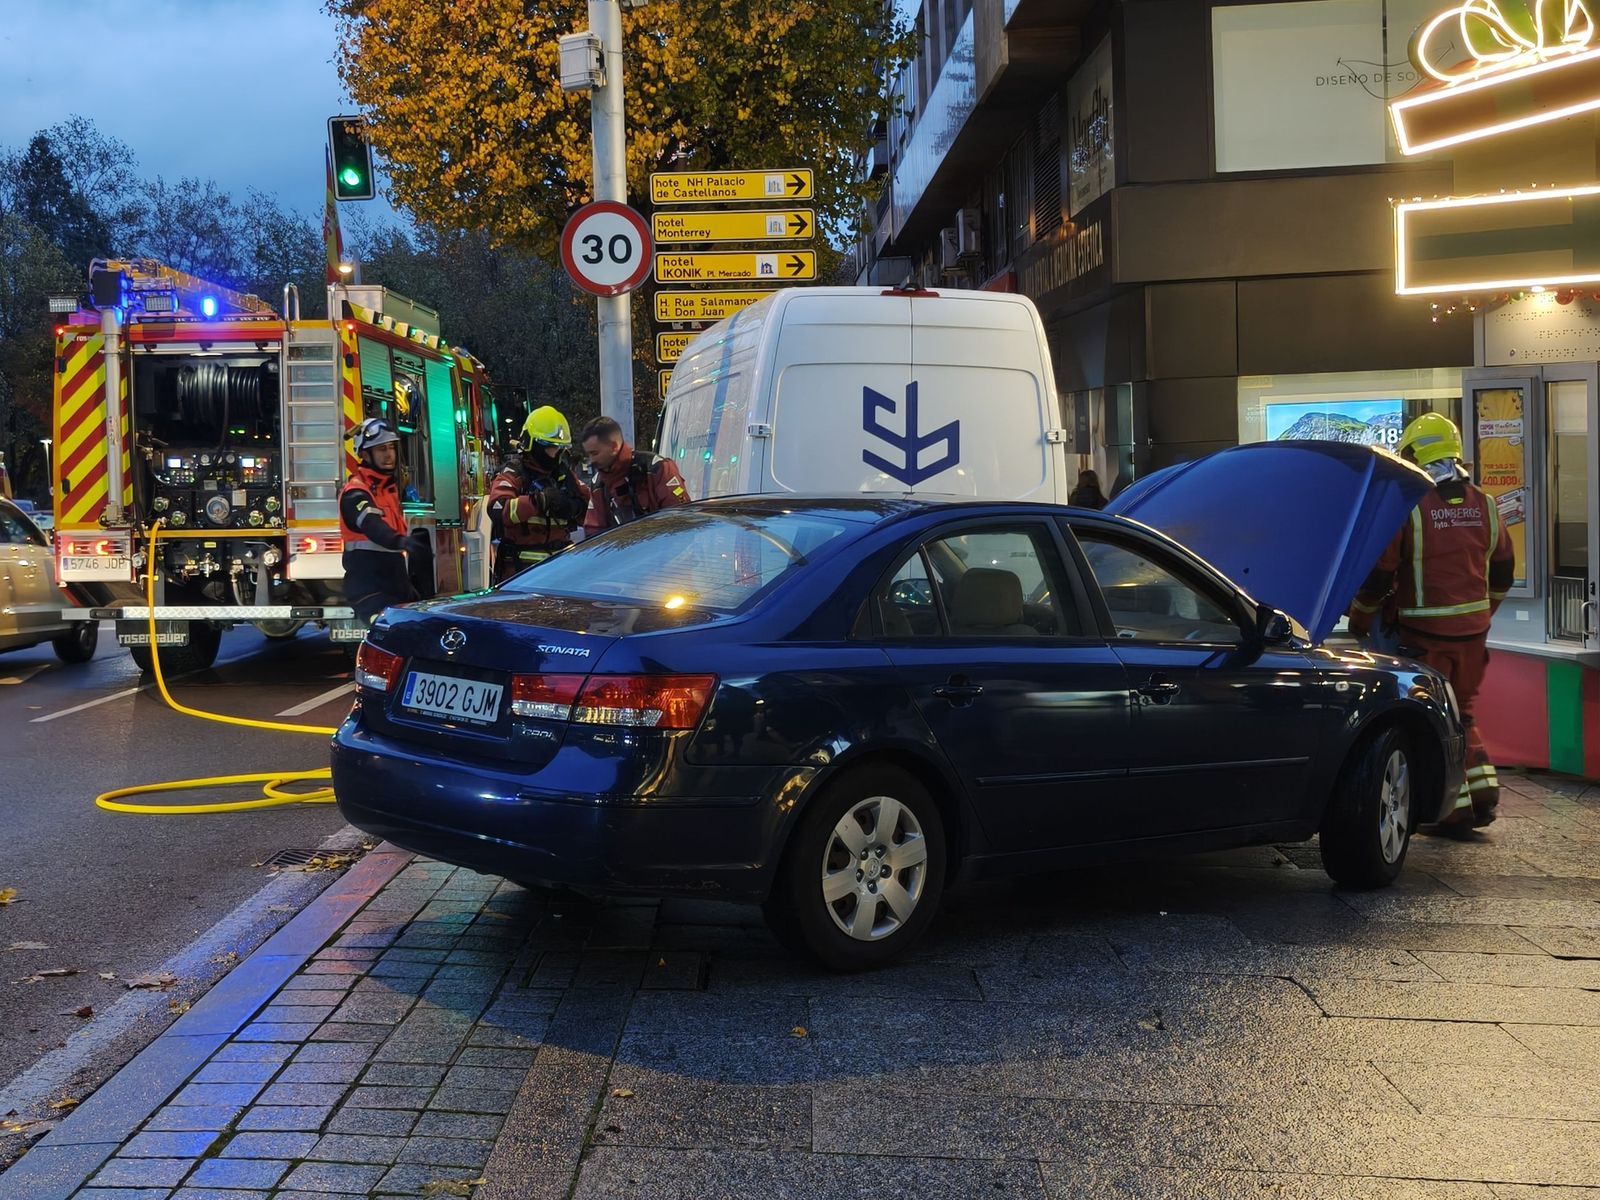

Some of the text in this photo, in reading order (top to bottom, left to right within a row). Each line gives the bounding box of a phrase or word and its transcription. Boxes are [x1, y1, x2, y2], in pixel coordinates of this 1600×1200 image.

[1373, 72, 1392, 83] DE
[687, 177, 703, 187] NH
[707, 176, 746, 187] Palacio
[656, 188, 737, 199] de Castellanos
[657, 218, 685, 228] hotel
[658, 228, 711, 239] Monterrey
[581, 233, 633, 265] 30
[663, 257, 694, 267] hotel
[663, 267, 702, 278] IKONIK
[718, 270, 752, 278] Mercado
[660, 299, 670, 307] H.
[675, 298, 695, 307] Rúa
[660, 307, 725, 317] H. Don Juan
[663, 338, 689, 347] hotel
[1431, 507, 1481, 520] BOMBEROS
[70, 558, 99, 570] 5746
[536, 644, 590, 658] SONATA
[416, 678, 459, 710] 3902
[461, 685, 499, 717] GJM
